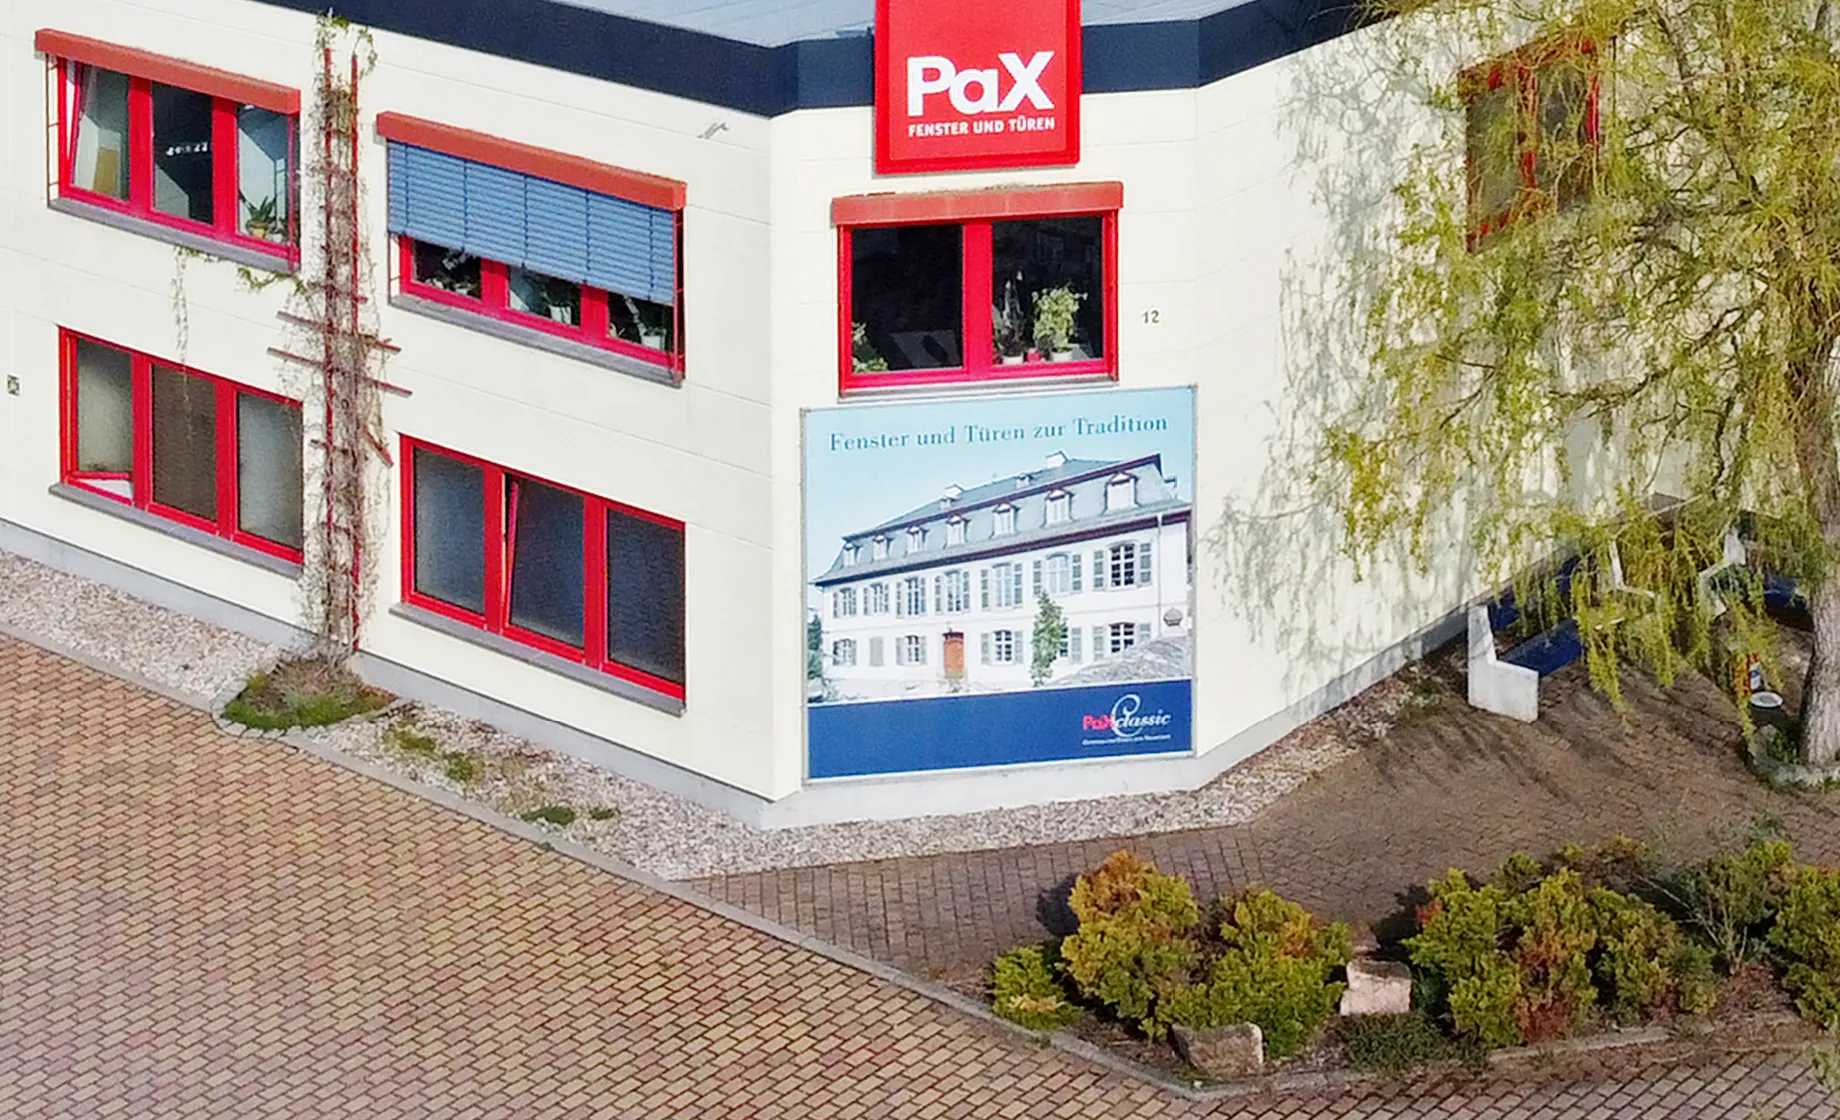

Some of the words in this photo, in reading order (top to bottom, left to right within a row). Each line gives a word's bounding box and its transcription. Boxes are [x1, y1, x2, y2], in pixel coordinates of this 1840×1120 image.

[907, 51, 1055, 117] PaX
[908, 121, 969, 138] FENSTER
[973, 119, 1005, 134] UND
[1009, 115, 1055, 132] TÜREN
[1141, 309, 1160, 324] 12
[829, 432, 910, 452] Fenster
[917, 427, 956, 446] und
[964, 424, 1026, 443] Türen
[1033, 423, 1067, 440] zur
[1072, 414, 1168, 437] Tradition
